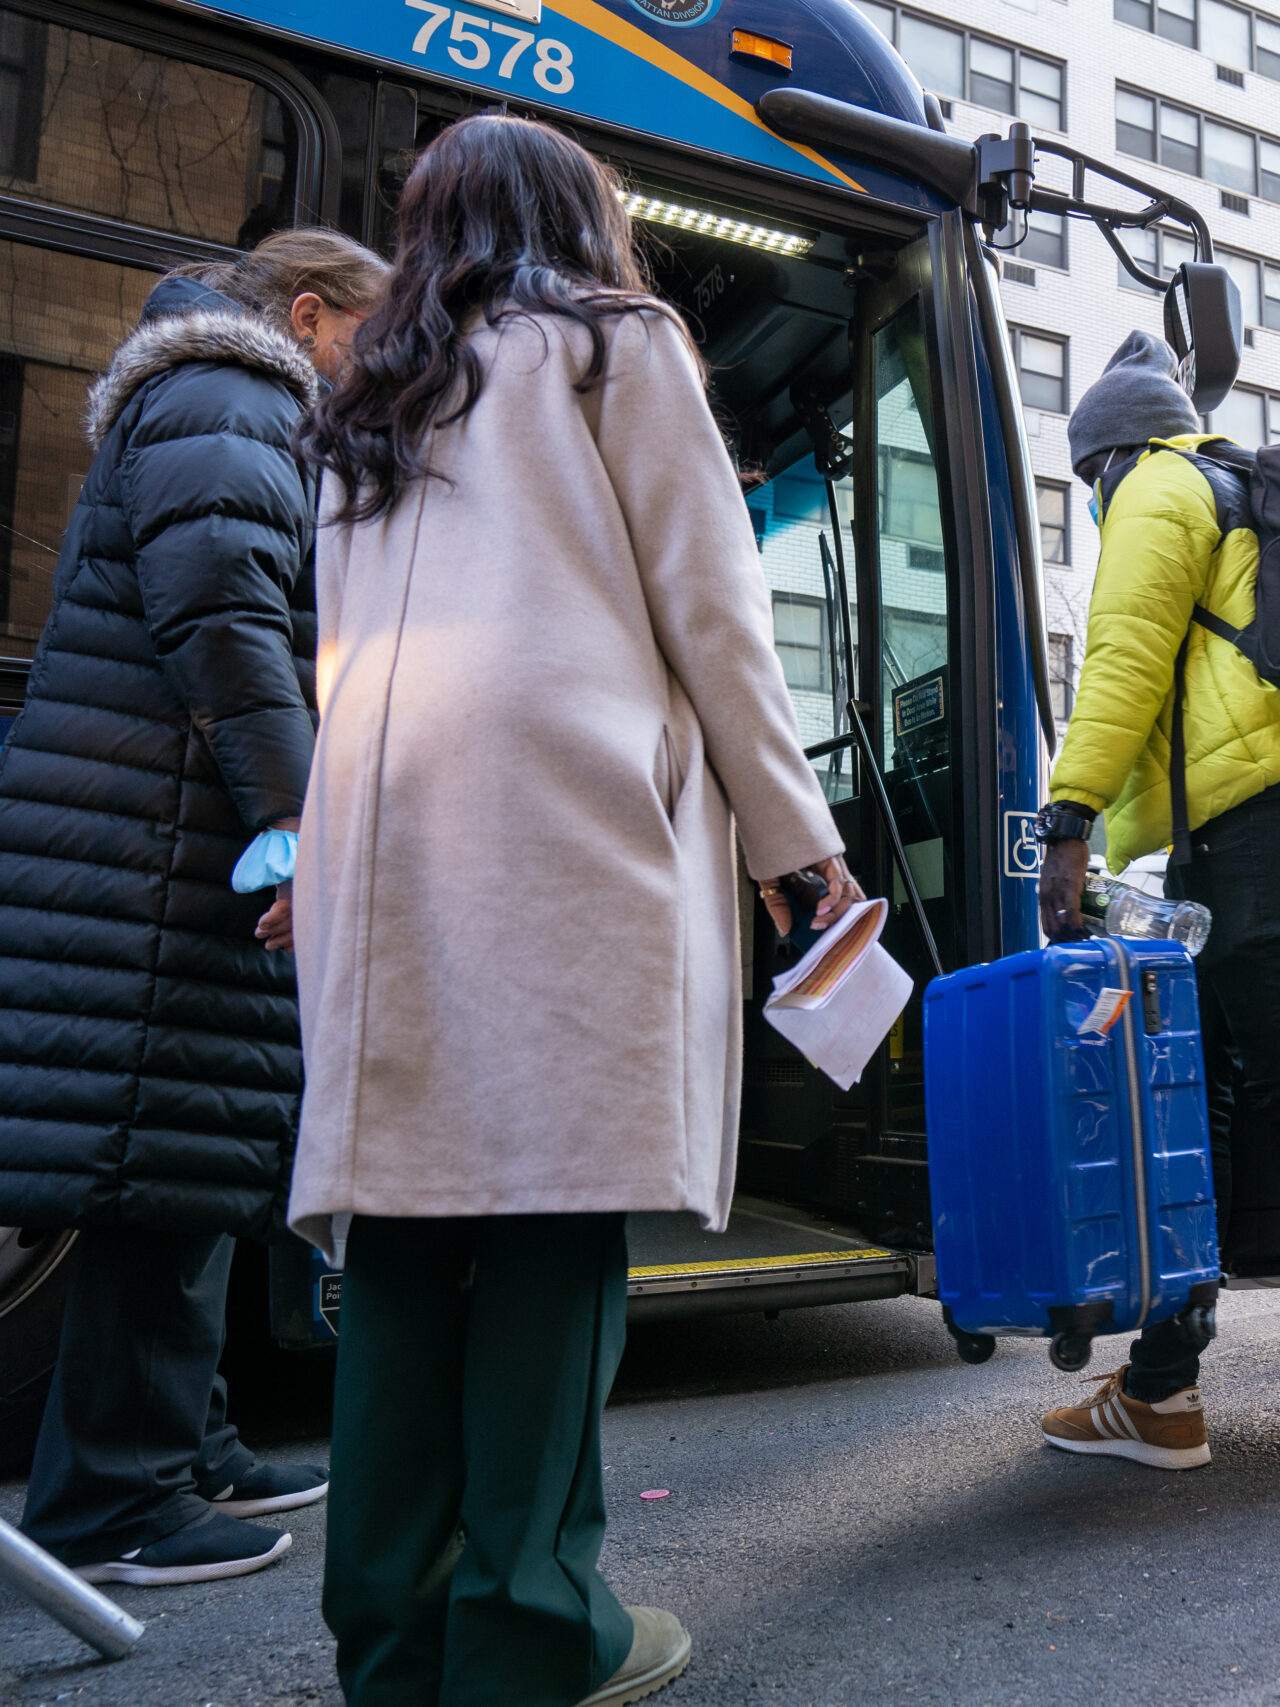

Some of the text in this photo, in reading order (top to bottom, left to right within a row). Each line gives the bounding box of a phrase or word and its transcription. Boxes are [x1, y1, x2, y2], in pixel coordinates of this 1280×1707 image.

[672, 0, 706, 20] DIVISION
[405, 0, 575, 95] 7578
[693, 263, 725, 314] 7578
